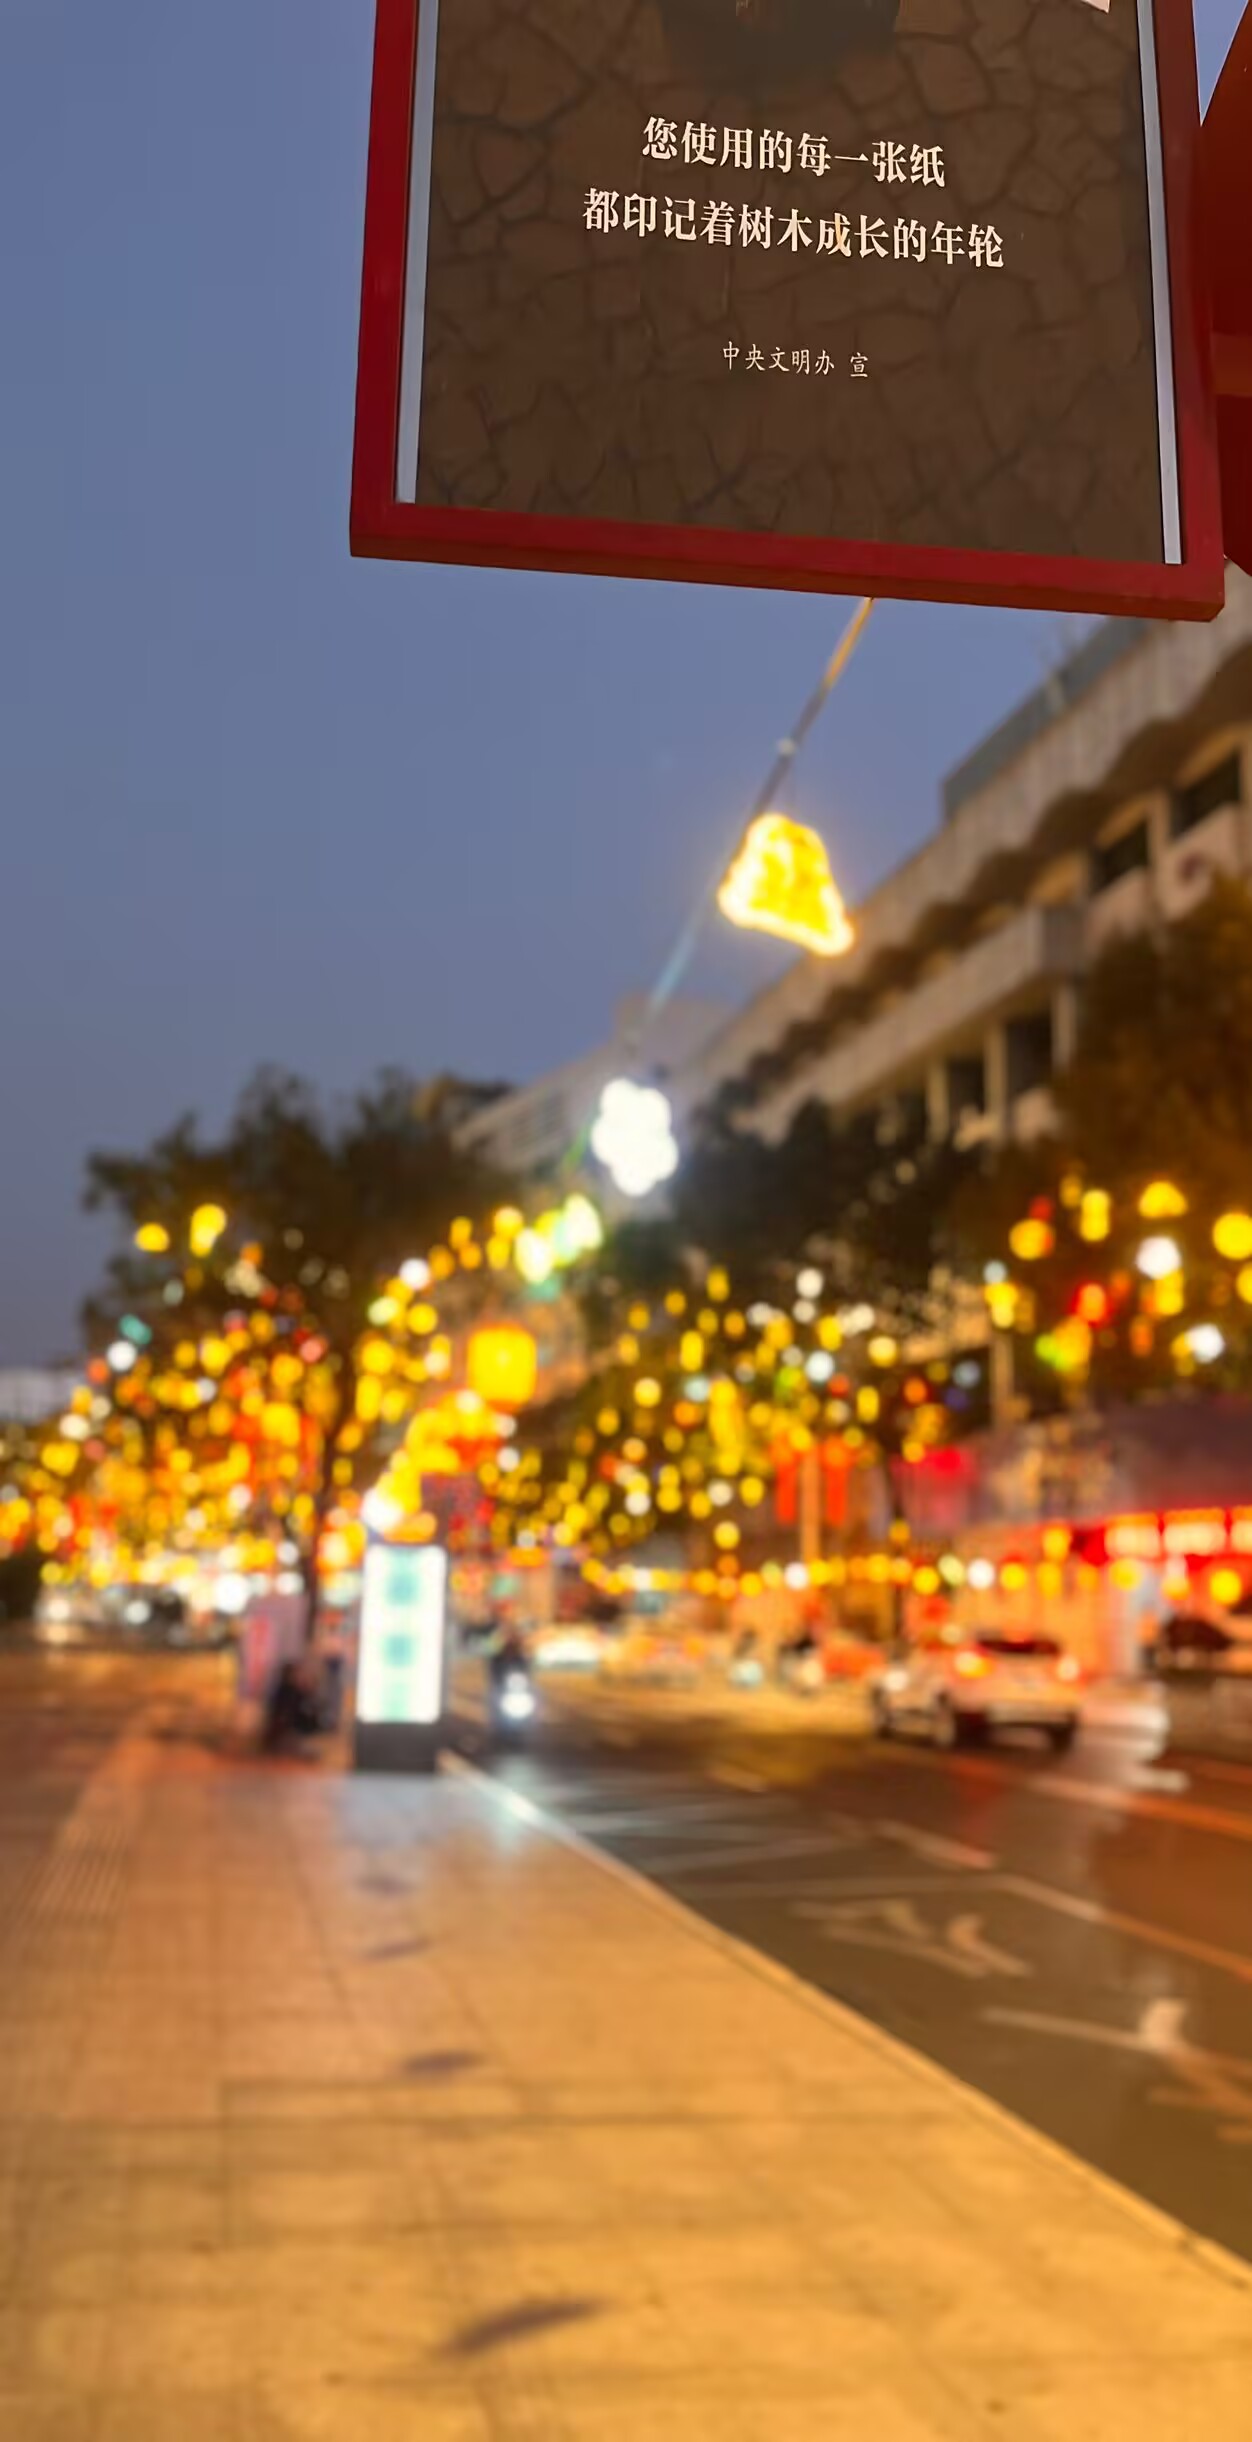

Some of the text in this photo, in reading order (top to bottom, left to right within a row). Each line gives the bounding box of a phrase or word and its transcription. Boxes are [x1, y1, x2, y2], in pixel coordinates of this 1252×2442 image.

[642, 116, 946, 188] 您使用的每一张纸
[582, 187, 1005, 269] 都印记着树木成长的年轮
[722, 340, 869, 378] 中央文明办 宣
